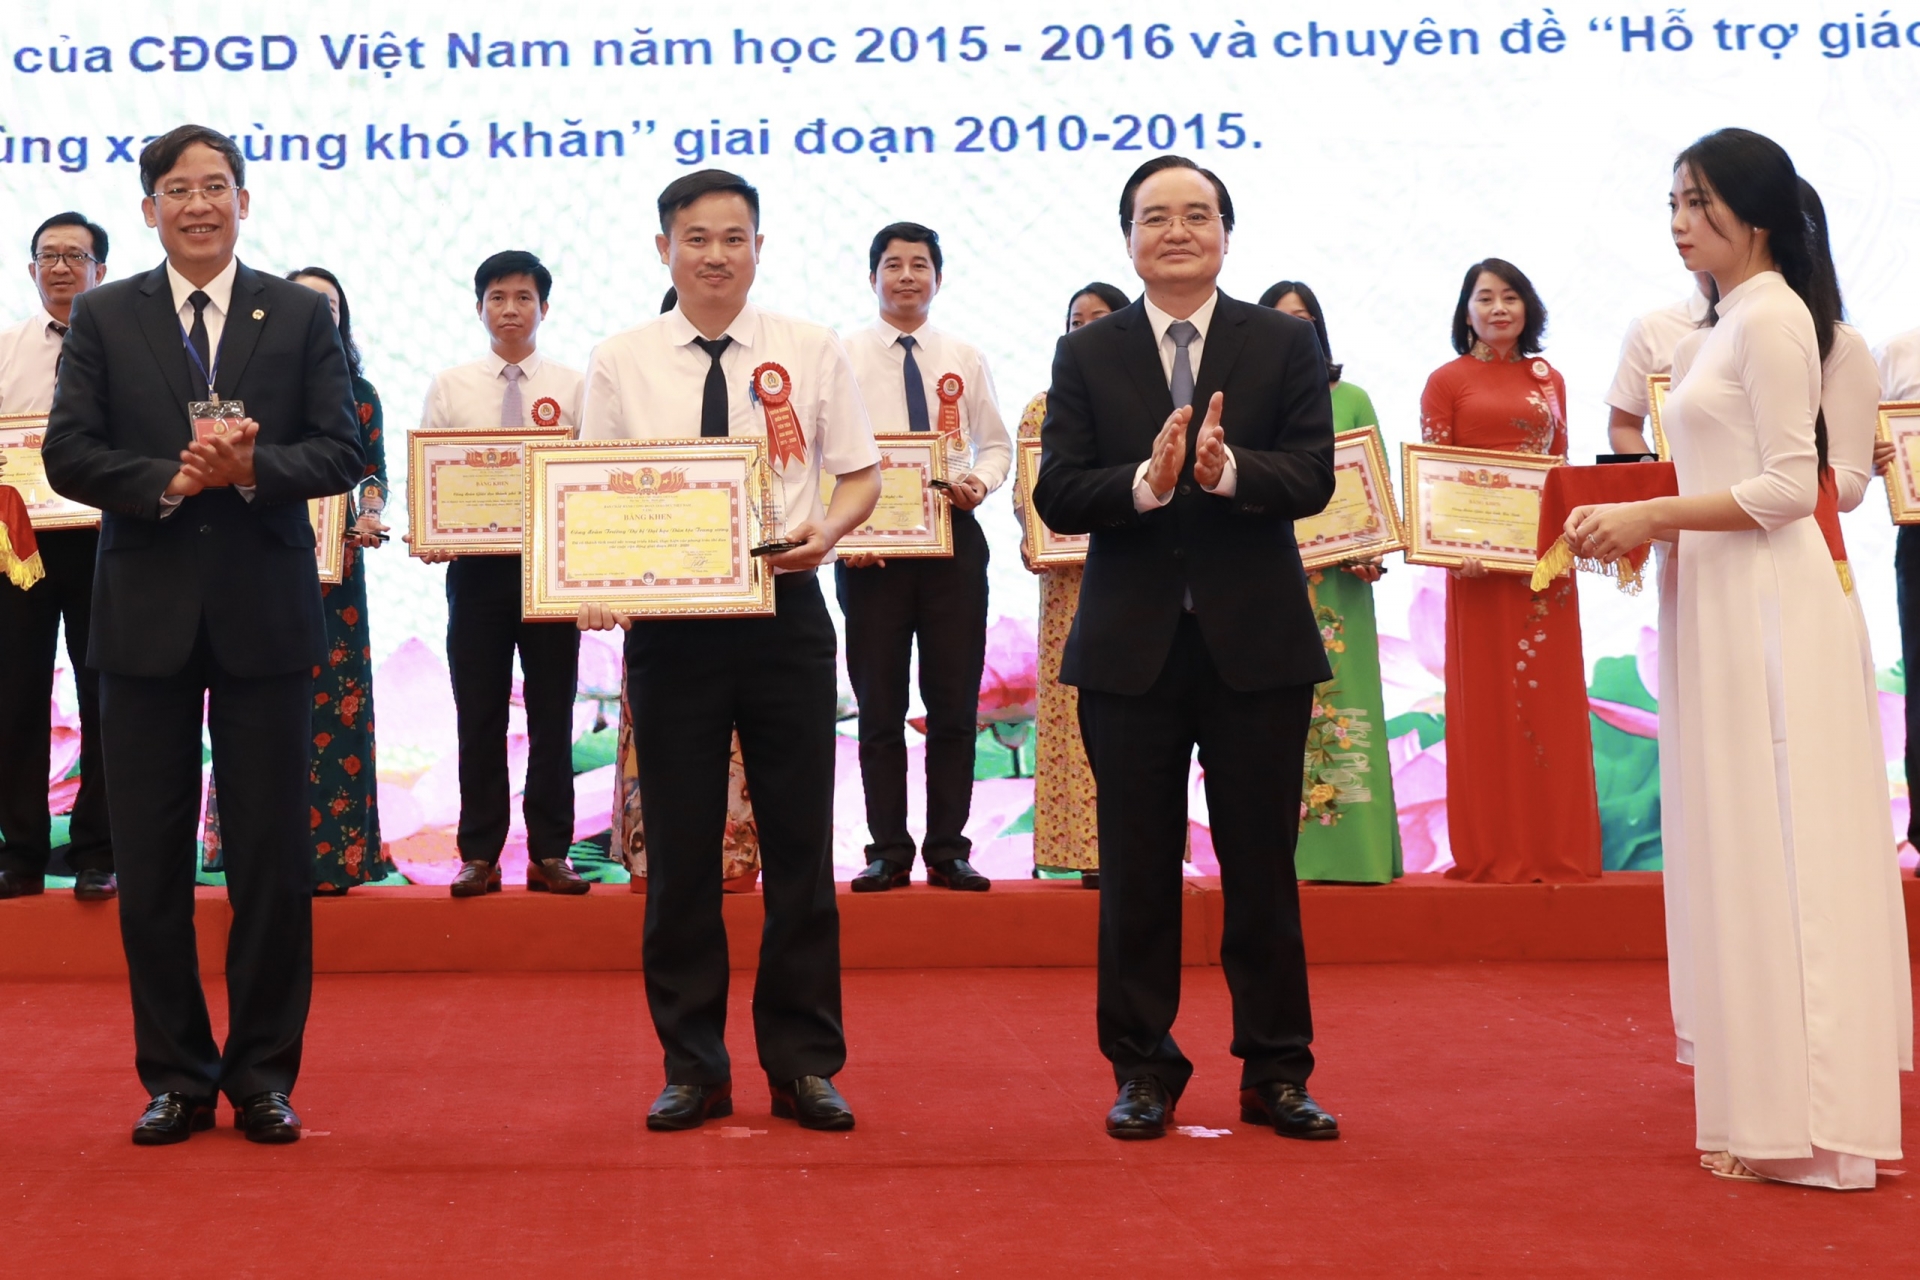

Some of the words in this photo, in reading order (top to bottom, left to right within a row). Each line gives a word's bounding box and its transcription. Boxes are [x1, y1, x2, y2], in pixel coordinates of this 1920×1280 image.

[13, 35, 113, 74] của
[129, 35, 298, 74] CĐGD
[321, 31, 425, 79] Việt
[447, 31, 570, 69] Nam
[593, 27, 713, 67] năm
[733, 28, 838, 74] học
[855, 25, 989, 64] 2015
[1004, 43, 1022, 52] -
[1041, 23, 1175, 61] 2016
[1189, 20, 1258, 59] và
[1273, 17, 1480, 66] chuyên
[1500, 8, 1567, 54] đề
[1589, 8, 1694, 52] “Hỗ
[1713, 18, 1799, 60] trợ
[106, 135, 160, 163] x
[226, 122, 347, 170] ùng
[365, 119, 470, 160] khó
[489, 118, 656, 158] khăn”
[674, 118, 770, 166] giai
[794, 118, 936, 163] đoạn
[954, 112, 1262, 153] 2010-2015.
